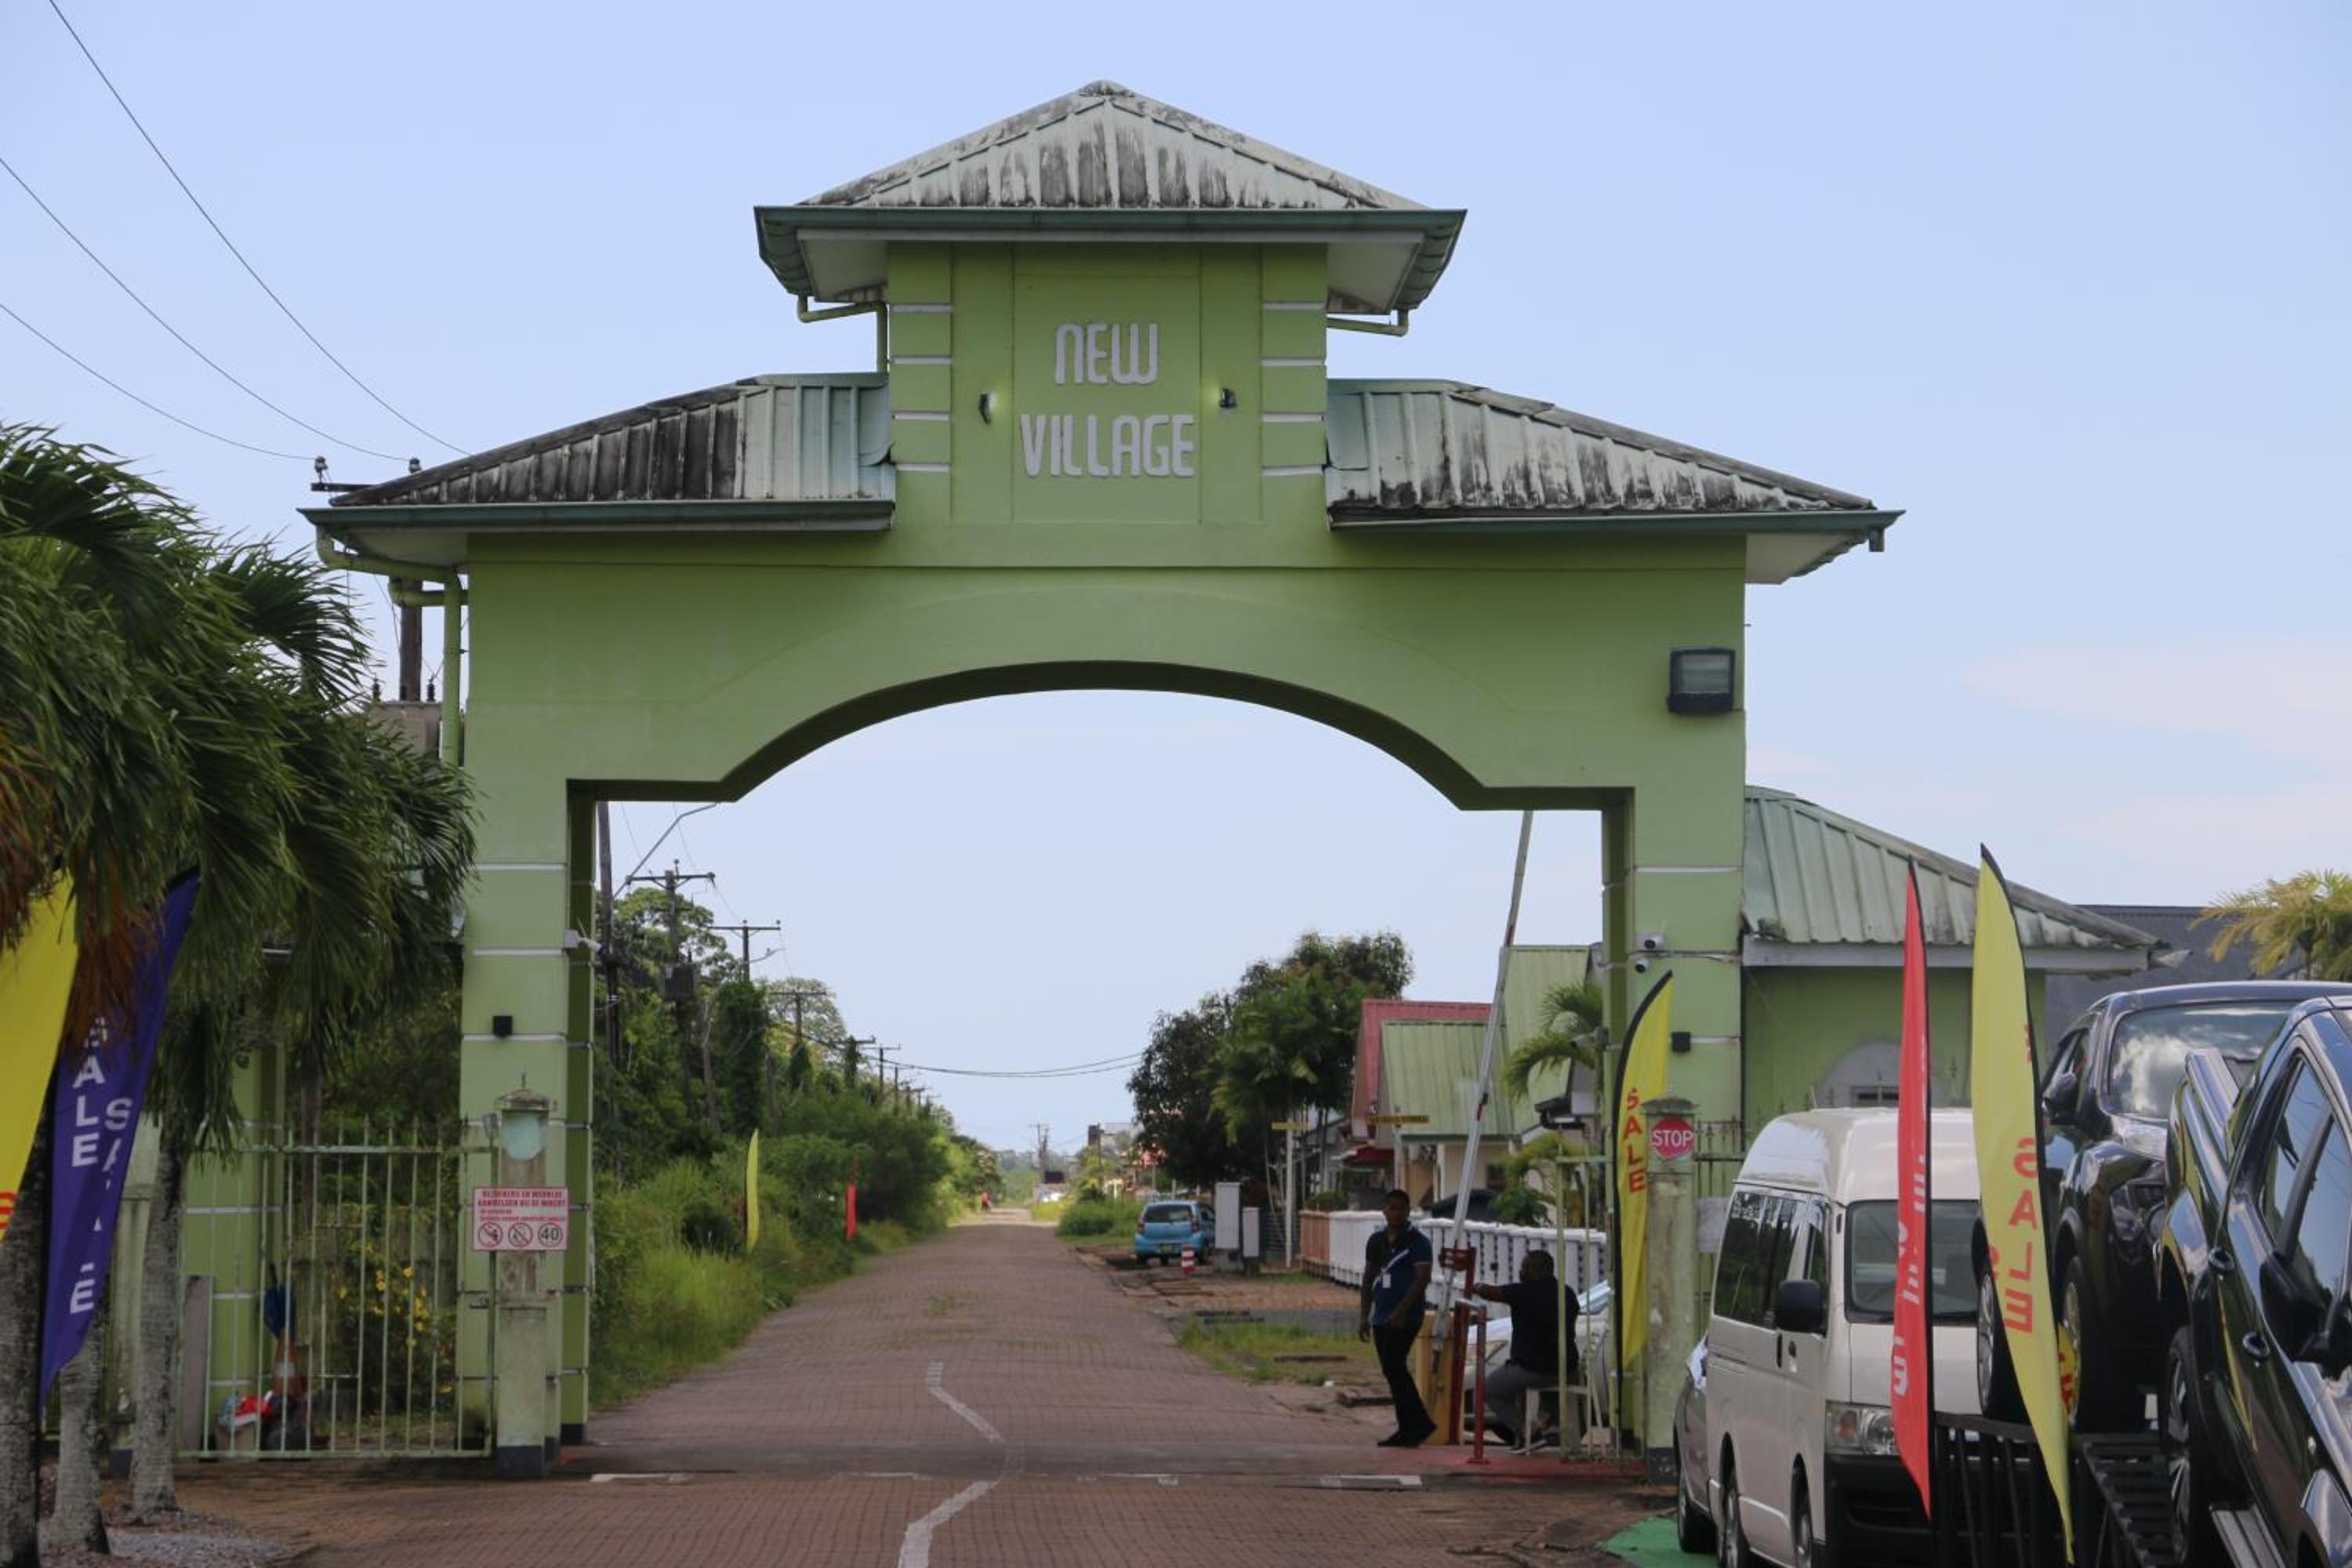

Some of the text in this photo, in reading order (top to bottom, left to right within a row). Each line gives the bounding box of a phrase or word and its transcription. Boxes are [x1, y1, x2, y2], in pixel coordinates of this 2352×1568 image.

[1054, 323, 1159, 384] NEW
[1021, 413, 1196, 477] VILLAGE
[1624, 1085, 1648, 1193] SALE
[1653, 1130, 1693, 1148] STOP
[541, 1228, 559, 1240] 40
